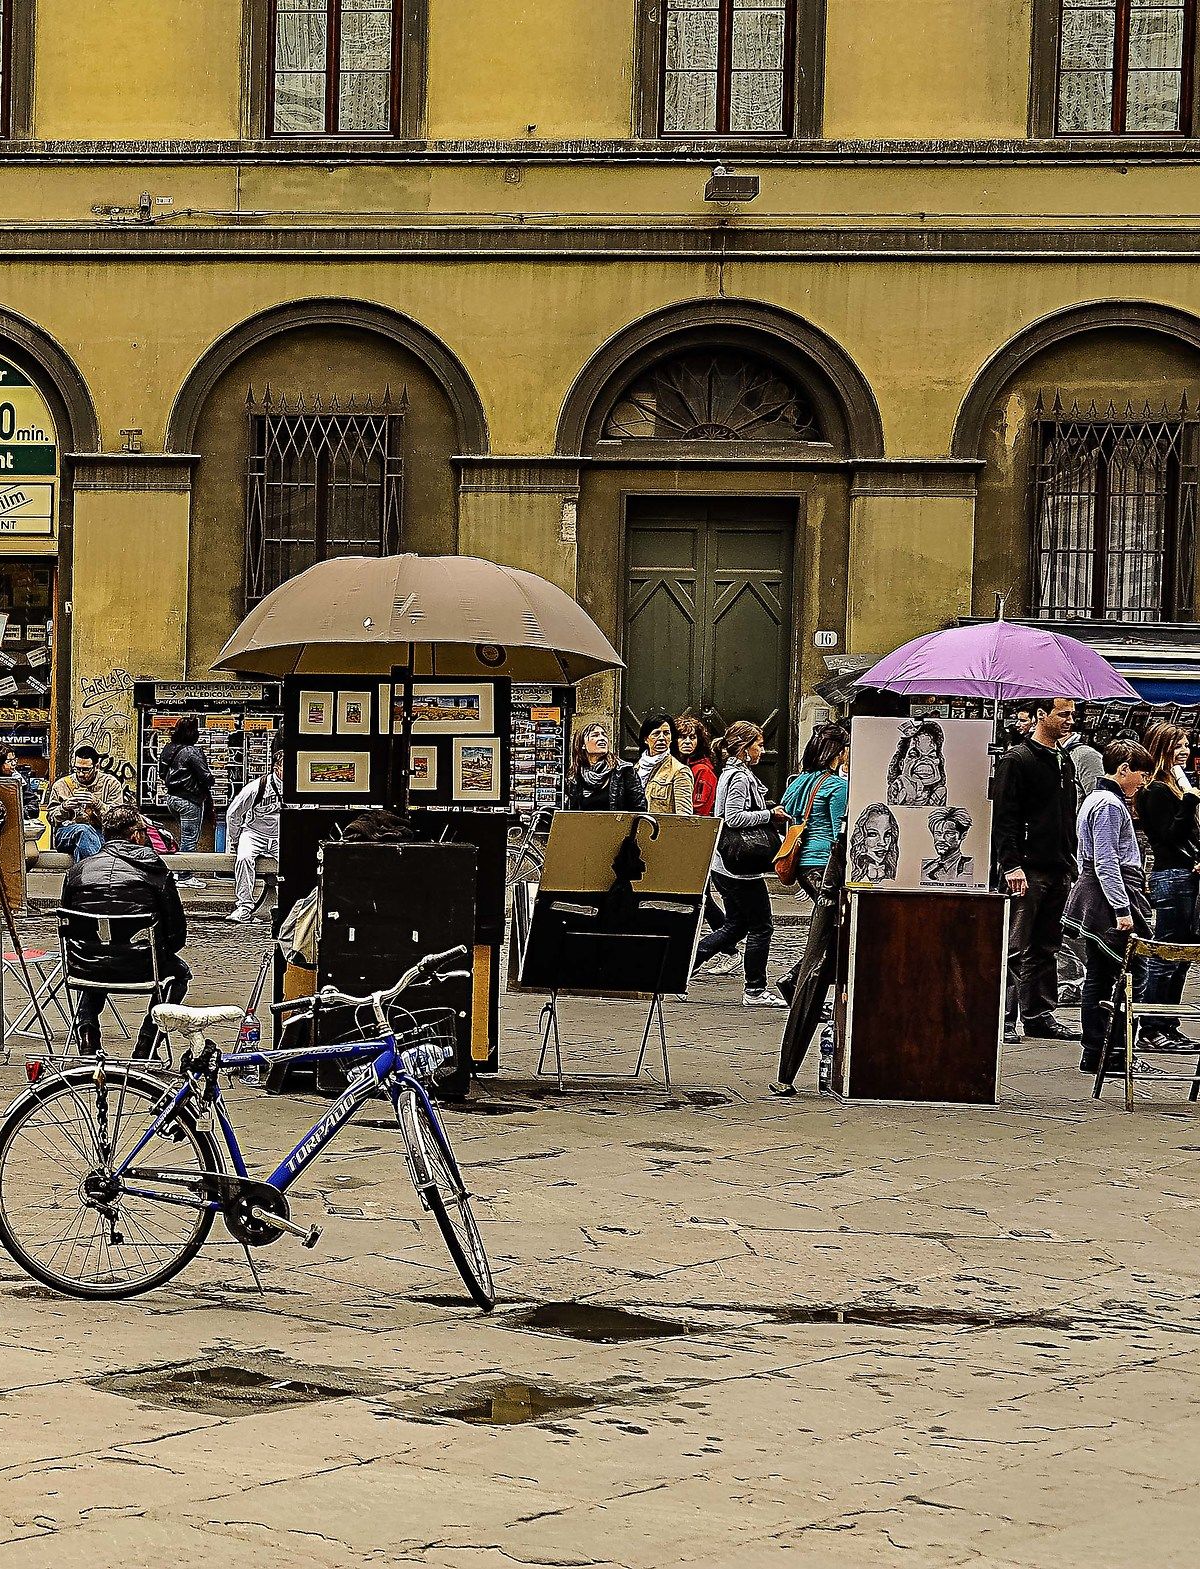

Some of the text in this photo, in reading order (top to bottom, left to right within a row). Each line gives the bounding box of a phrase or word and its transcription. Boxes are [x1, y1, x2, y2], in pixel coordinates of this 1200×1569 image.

[16, 424, 49, 442] min.
[819, 631, 832, 646] 16
[285, 1092, 356, 1173] TORPADO
